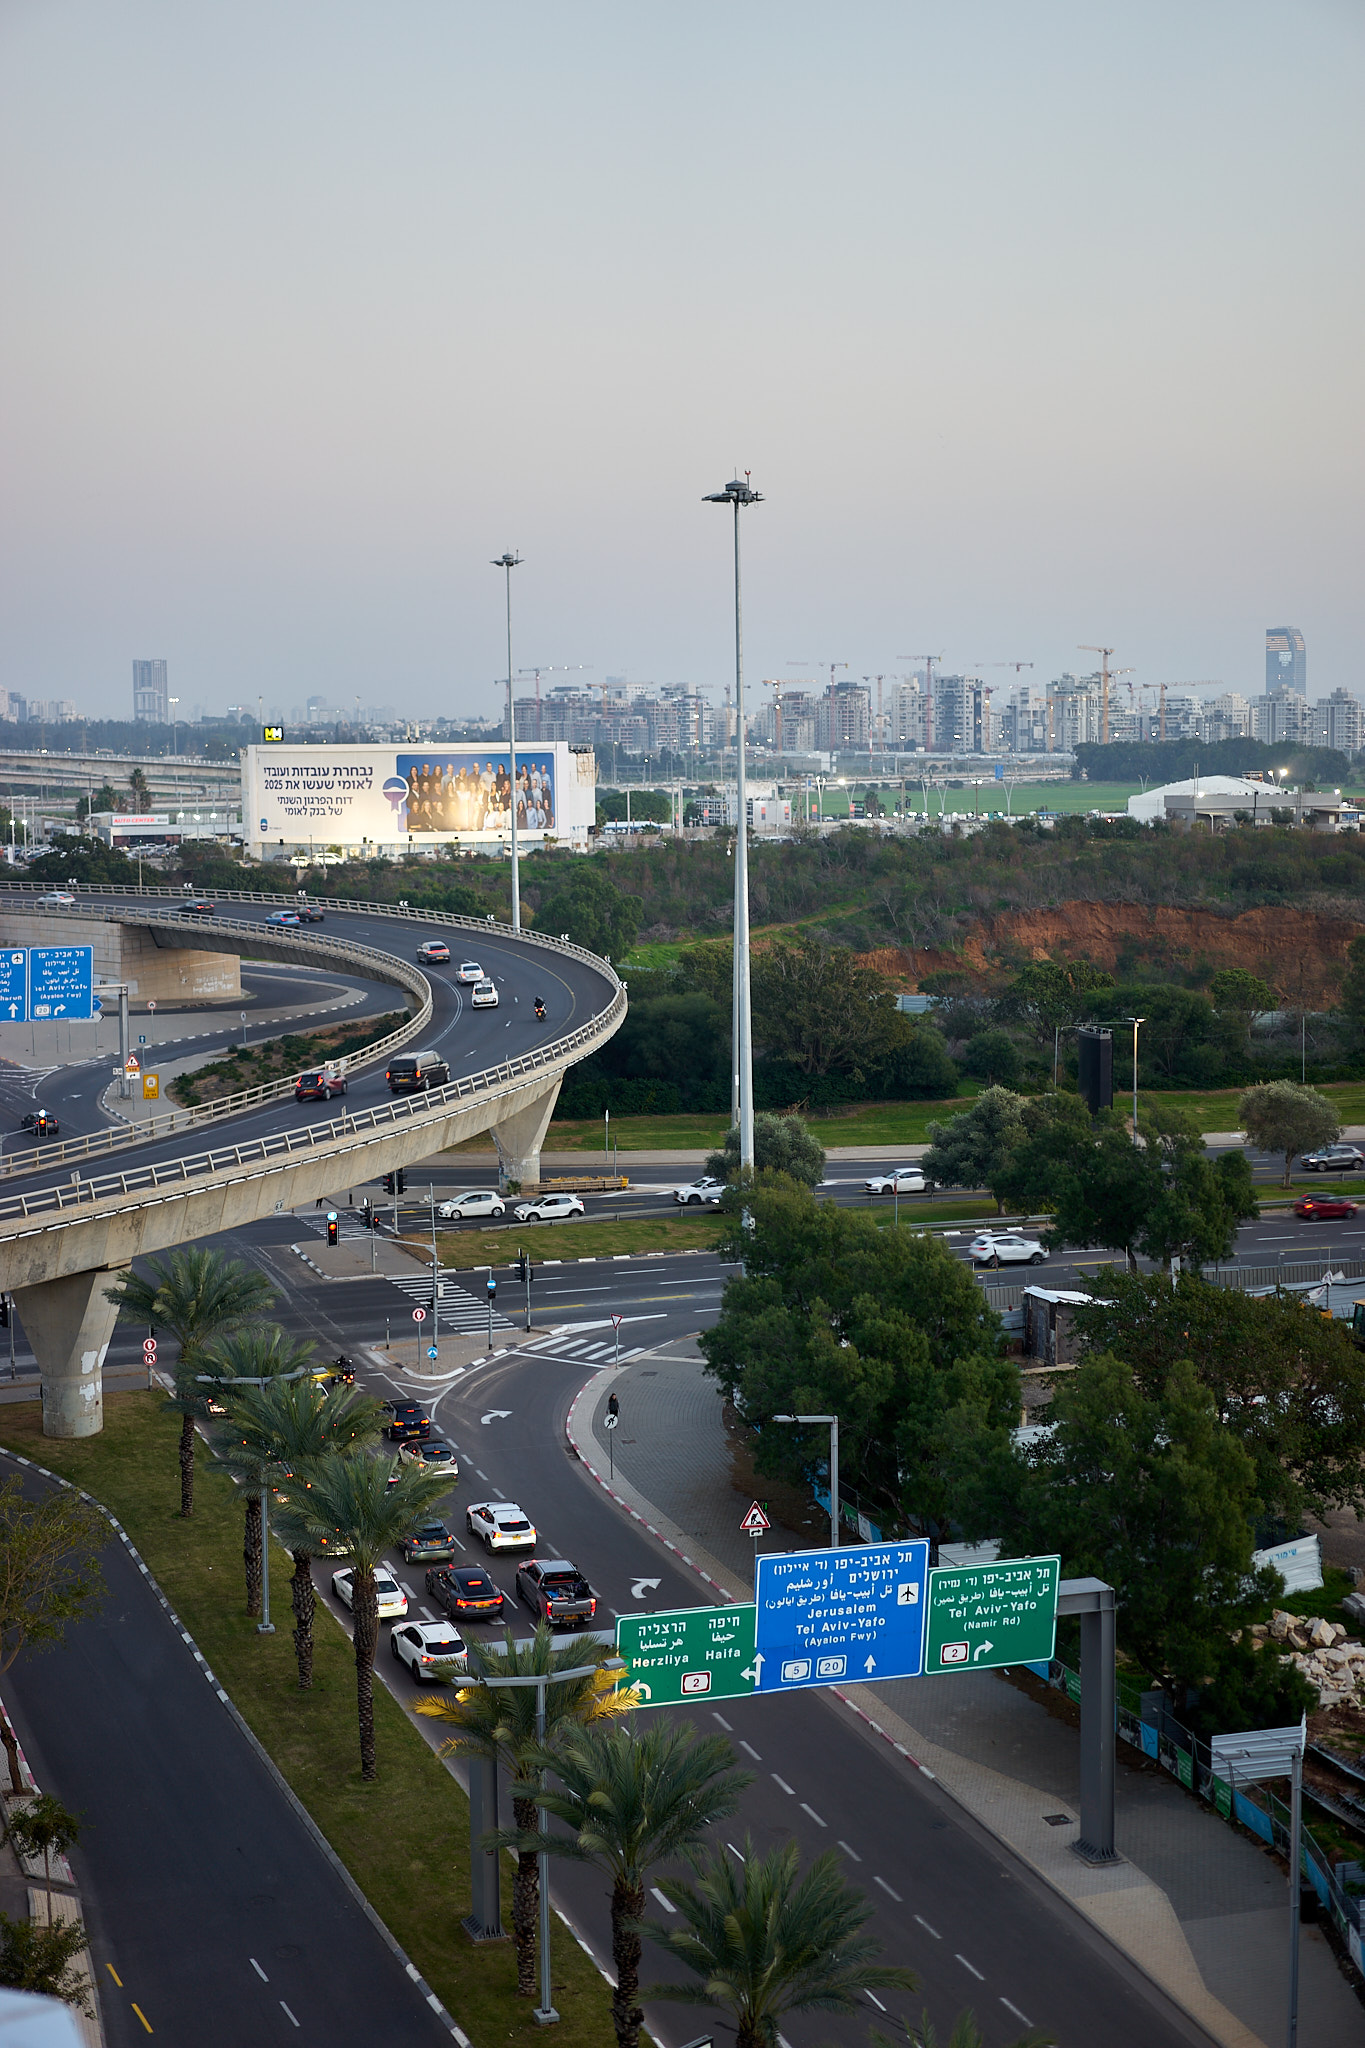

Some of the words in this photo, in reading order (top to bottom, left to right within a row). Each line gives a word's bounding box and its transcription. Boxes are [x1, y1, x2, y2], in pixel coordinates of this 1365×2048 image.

[263, 767, 289, 776] ועובדי
[292, 767, 329, 776] עובדות
[332, 767, 373, 776] נבחרת
[264, 780, 283, 789] 2025
[285, 780, 300, 789] את
[302, 780, 334, 789] שעשו
[338, 777, 373, 789] לאומי
[277, 796, 302, 804] השנתי
[304, 796, 333, 806] הפרגון
[335, 796, 353, 804] דוח
[285, 806, 307, 815] לאומי
[310, 808, 326, 817] בנק
[329, 806, 342, 815] של
[835, 1554, 890, 1569] אביב-יפו
[898, 1551, 912, 1562] תל
[774, 1562, 809, 1575] איילון)
[1036, 1567, 1050, 1578] תל
[849, 1568, 899, 1583] ירושלים
[982, 1569, 1031, 1584] אביב-יפו
[786, 1573, 833, 1593] أورشليم
[939, 1579, 960, 1590] נמיר)
[830, 1583, 875, 1601] أبيب-يافا
[880, 1584, 893, 1598] تل
[989, 1581, 1033, 1600] أبيب-يافا
[1037, 1583, 1050, 1597] تل
[796, 1593, 825, 1607] (طريق
[933, 1595, 955, 1606] نمير)
[958, 1592, 984, 1605] (طريق
[808, 1603, 876, 1619] Jerusalem
[949, 1607, 967, 1618] Tel
[975, 1600, 1037, 1616] Aviv-Yafo
[708, 1616, 740, 1629] חיפה
[796, 1624, 815, 1635] Tel
[821, 1616, 886, 1632] Aviv-Yafo
[964, 1619, 997, 1632] (Namir
[1002, 1616, 1020, 1627] Rd)
[638, 1622, 686, 1637] הרצליה
[711, 1632, 735, 1644] حيفا
[804, 1635, 846, 1648] (Ayalon
[850, 1631, 876, 1643] Fwy)
[706, 1648, 741, 1660] Haifa
[952, 1649, 958, 1657] 2
[632, 1654, 689, 1668] Herzliya
[793, 1666, 800, 1675] 5
[824, 1661, 839, 1671] 20
[693, 1679, 700, 1688] 2
